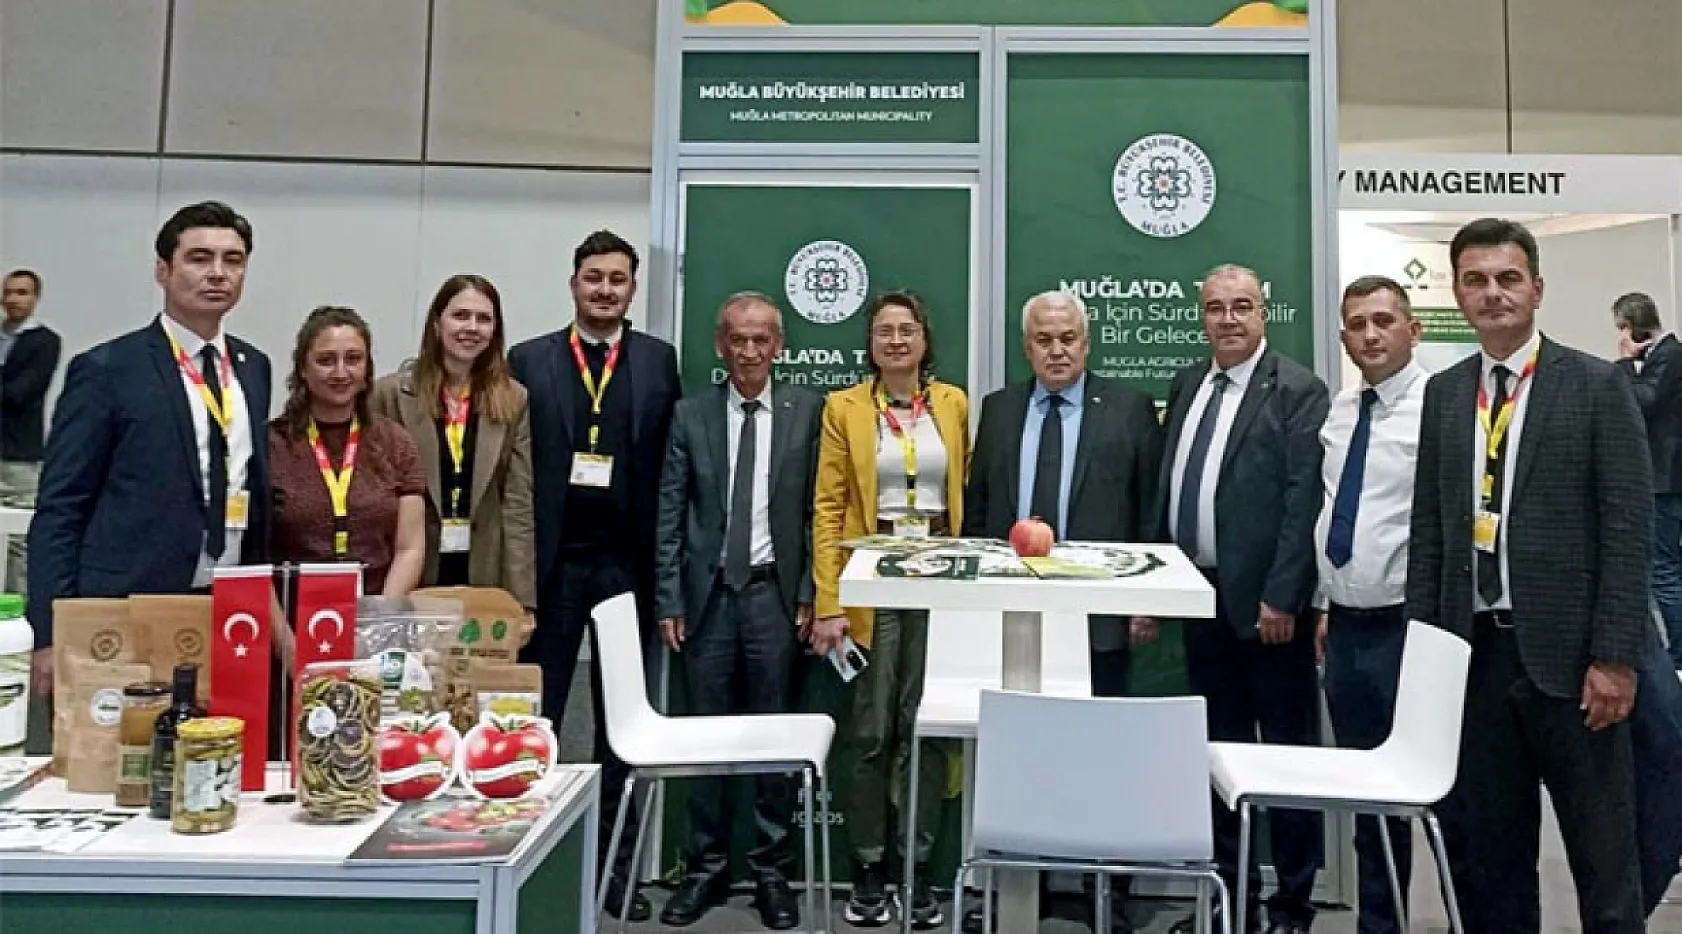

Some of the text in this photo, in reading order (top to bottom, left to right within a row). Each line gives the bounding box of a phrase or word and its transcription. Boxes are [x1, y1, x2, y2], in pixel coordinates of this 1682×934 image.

[699, 81, 964, 102] MUĞLA BÜYÜKŞEHİR BELEDİYESİ
[730, 108, 932, 121] MUĞLA METROPOLITAN MUNICIPALITY
[1355, 171, 1566, 195] MANAGEMENT
[1059, 275, 1185, 299] MUĞLA'DA
[1106, 300, 1142, 326] İçin
[1101, 324, 1210, 344] Bir Gelece
